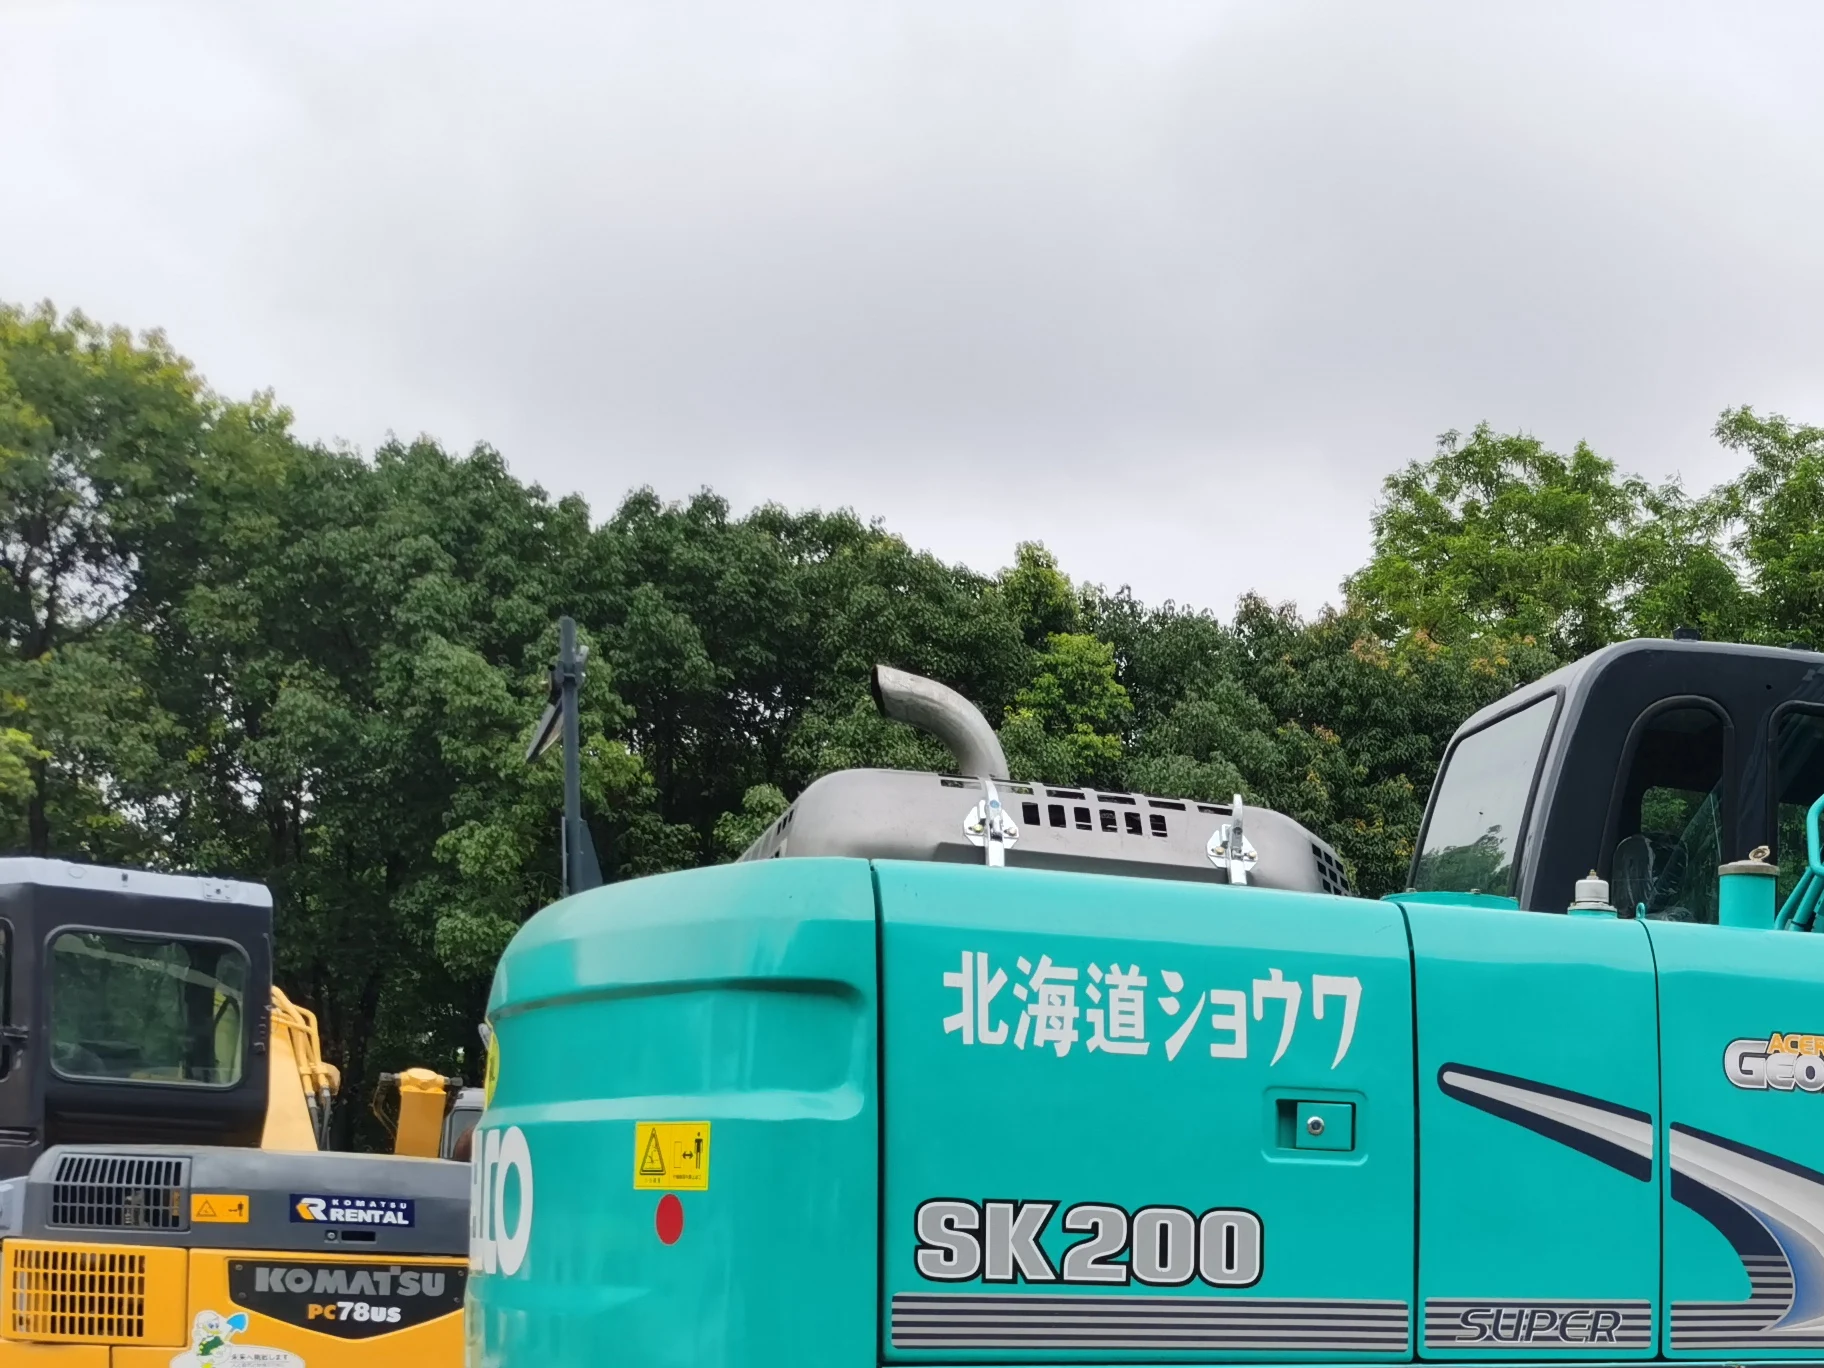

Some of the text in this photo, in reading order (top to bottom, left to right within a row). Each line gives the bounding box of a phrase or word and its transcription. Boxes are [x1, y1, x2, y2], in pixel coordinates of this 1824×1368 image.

[942, 950, 1363, 1070] 北海道ショウワ
[330, 1209, 409, 1225] RENTAL
[332, 1198, 407, 1210] KOMATSU
[914, 1197, 1264, 1288] SK200
[255, 1266, 445, 1296] KOMATSU
[308, 1302, 401, 1322] PC78US
[1455, 1308, 1623, 1343] SUPER
